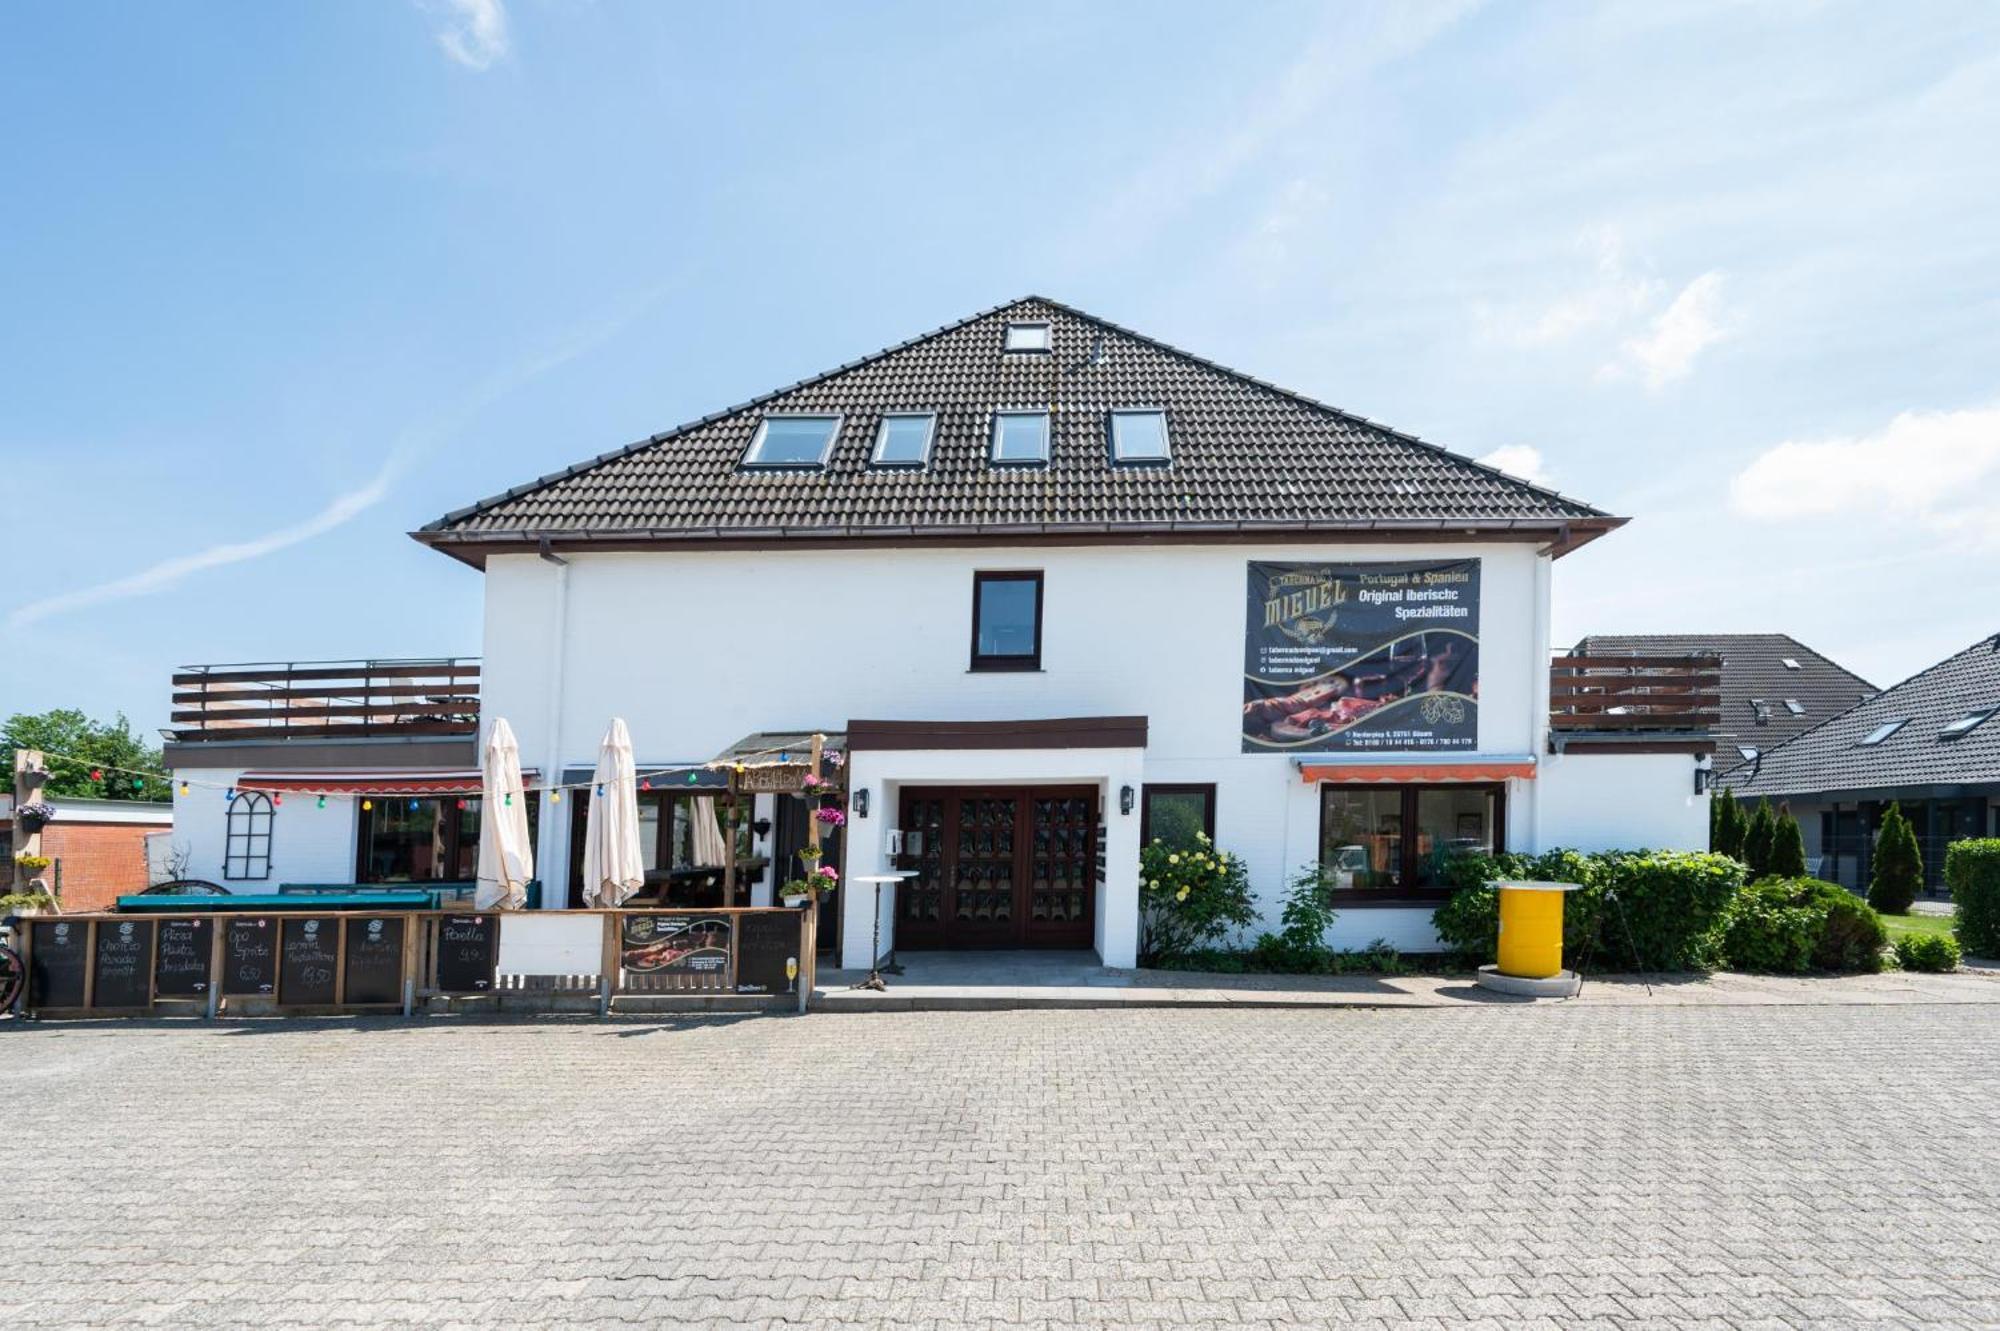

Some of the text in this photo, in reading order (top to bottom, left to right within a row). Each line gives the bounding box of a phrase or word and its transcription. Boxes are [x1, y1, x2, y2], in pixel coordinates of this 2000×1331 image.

[1412, 572, 1420, 583] &
[1424, 571, 1469, 585] Spanien
[1263, 579, 1346, 629] MIGUEL
[1359, 589, 1402, 604] Original
[1395, 605, 1468, 620] Spezialitäten
